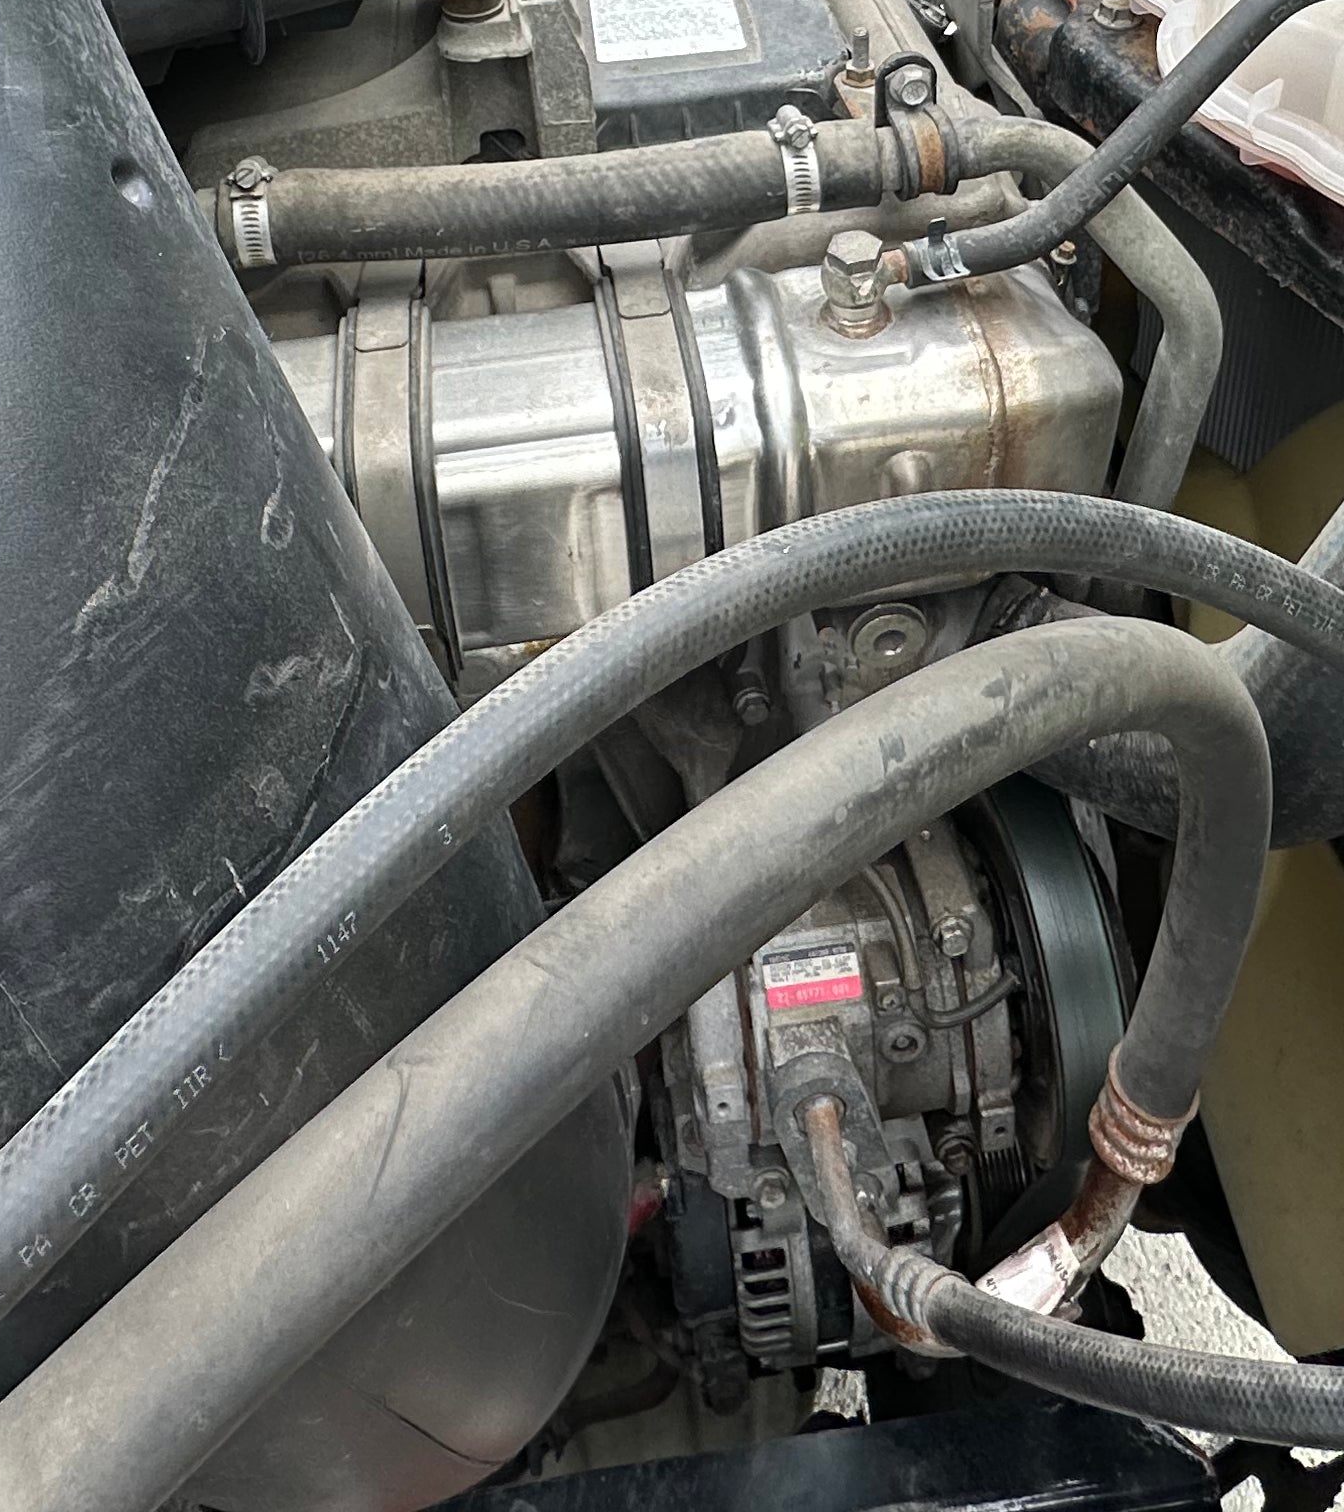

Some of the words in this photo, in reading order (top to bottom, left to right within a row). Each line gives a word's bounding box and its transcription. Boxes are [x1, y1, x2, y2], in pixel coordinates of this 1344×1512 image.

[406, 246, 463, 259] Made
[468, 245, 487, 255] in
[316, 911, 360, 965] 1147
[18, 1233, 52, 1268] PA
[68, 1181, 101, 1219] CR
[113, 1120, 157, 1170] PET
